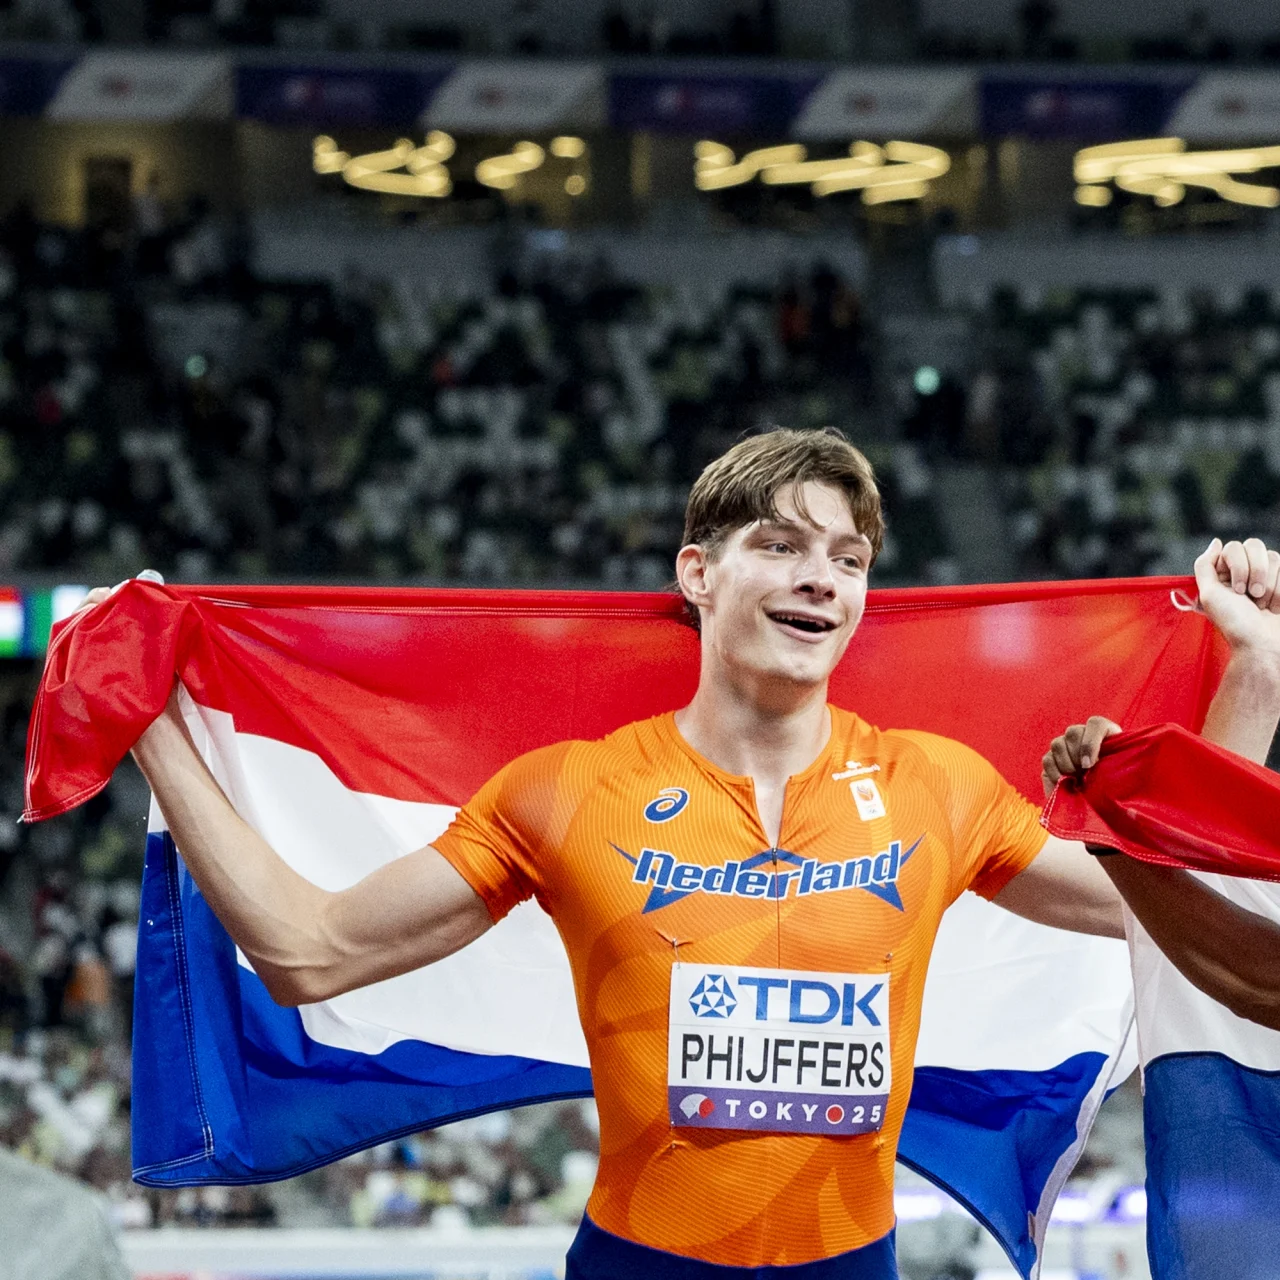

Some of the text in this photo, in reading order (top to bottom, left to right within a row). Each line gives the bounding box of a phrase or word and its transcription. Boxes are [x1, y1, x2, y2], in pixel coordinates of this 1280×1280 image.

[632, 840, 901, 901] Nederland
[737, 976, 884, 1027] TDK
[681, 1033, 884, 1088] PHIJFFERS
